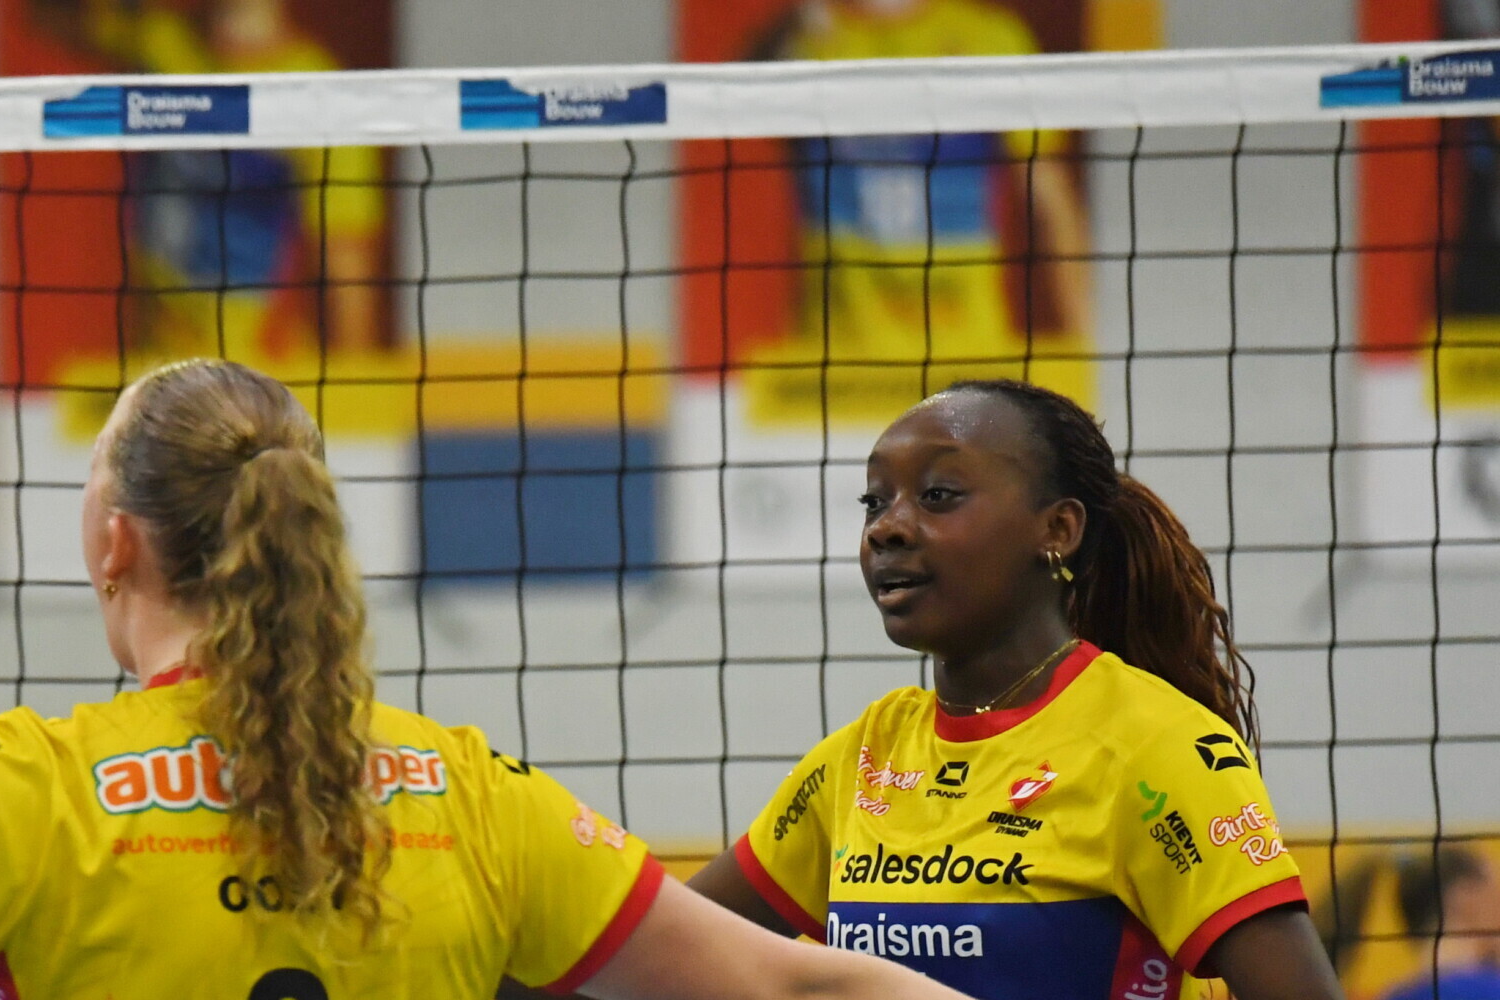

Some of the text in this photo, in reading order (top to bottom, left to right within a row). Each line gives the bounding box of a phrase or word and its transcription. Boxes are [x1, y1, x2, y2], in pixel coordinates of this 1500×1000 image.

[1409, 78, 1468, 97] Bouw
[127, 110, 187, 129] Bouw
[986, 811, 1044, 831] DRAISMA
[1164, 809, 1203, 865] KIEVIT
[840, 842, 1035, 886] salesdock
[1150, 822, 1192, 875] SPORT
[826, 911, 984, 958] Draisma
